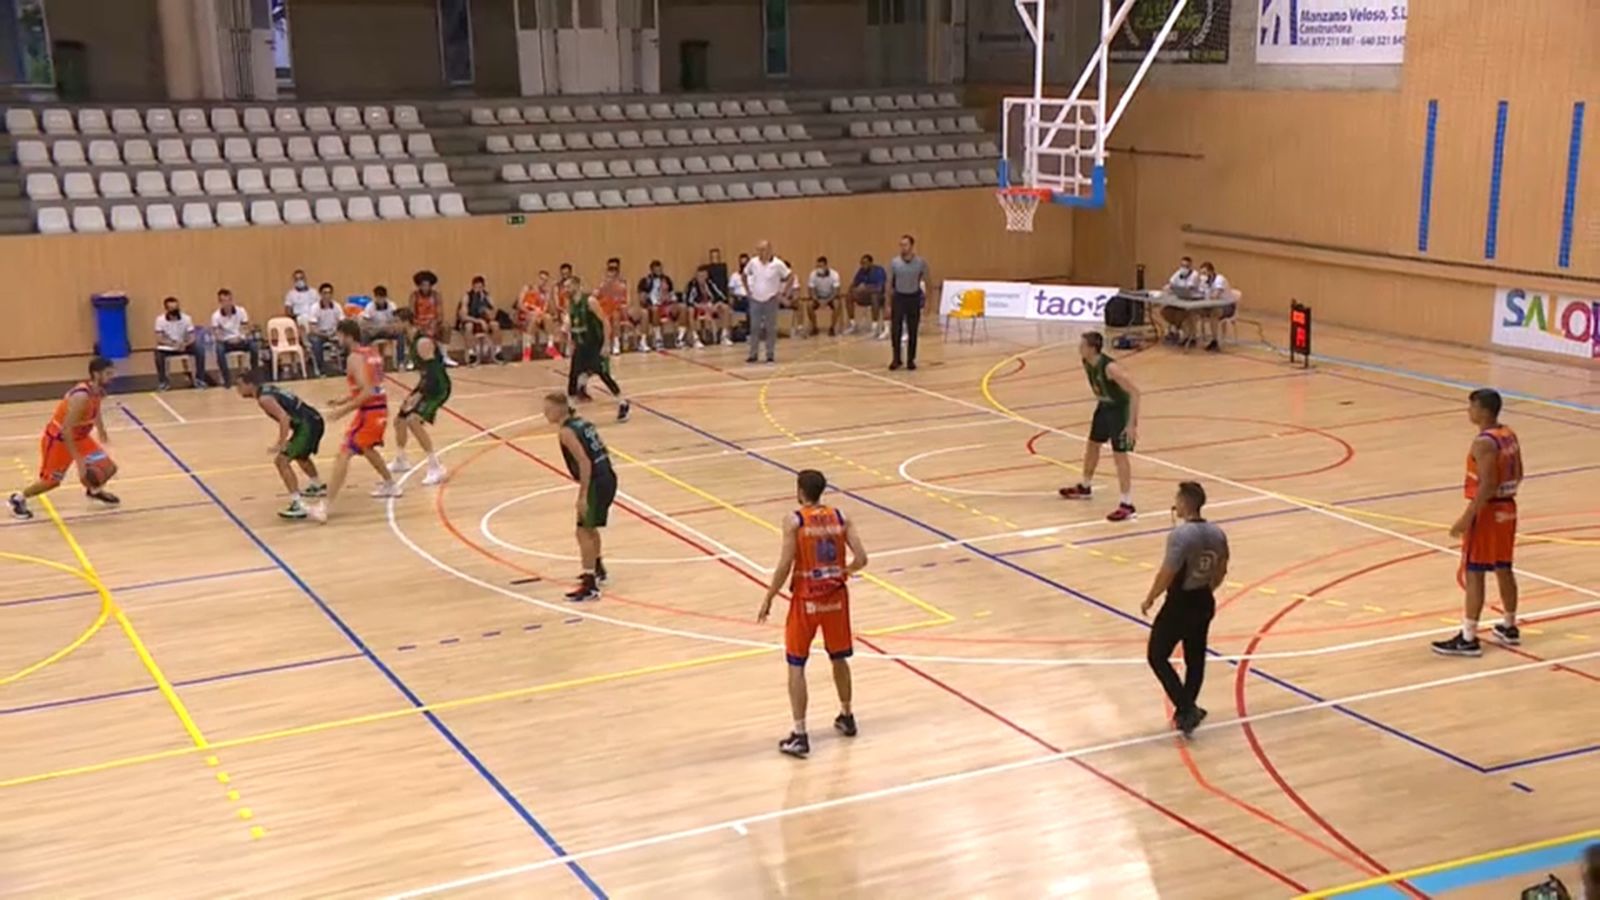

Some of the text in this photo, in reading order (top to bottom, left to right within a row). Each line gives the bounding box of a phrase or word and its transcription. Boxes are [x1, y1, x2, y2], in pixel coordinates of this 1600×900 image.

[1300, 10, 1347, 22] Manzano
[1349, 7, 1388, 22] Veloso,
[1300, 23, 1352, 34] Constructora
[1503, 288, 1600, 342] SALO
